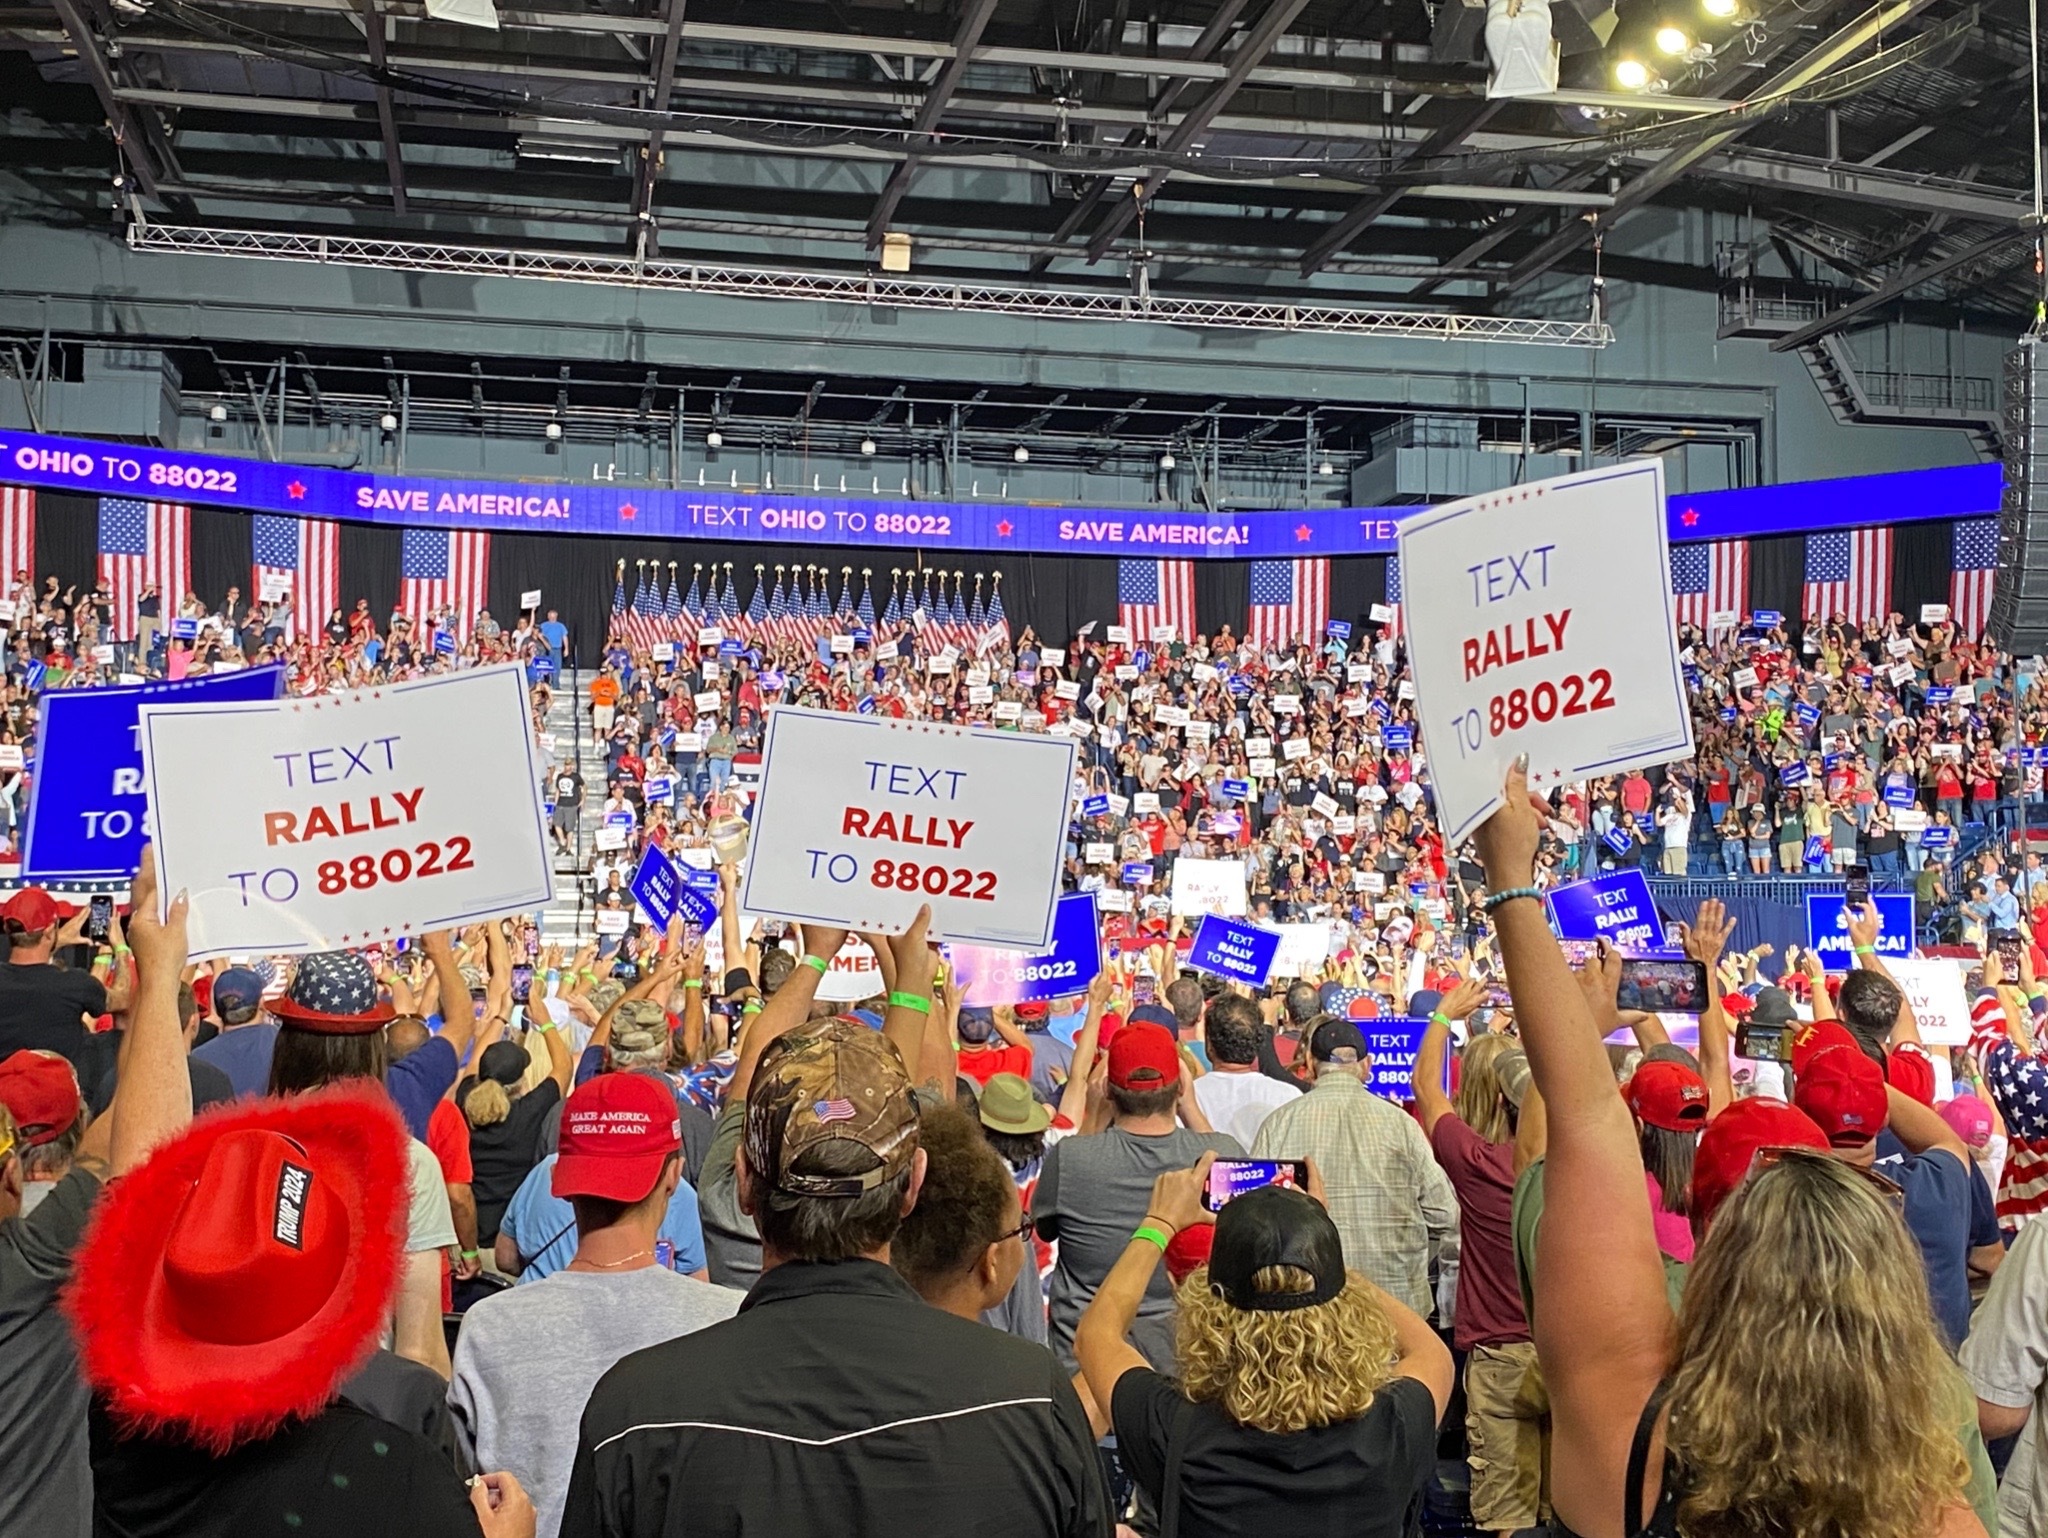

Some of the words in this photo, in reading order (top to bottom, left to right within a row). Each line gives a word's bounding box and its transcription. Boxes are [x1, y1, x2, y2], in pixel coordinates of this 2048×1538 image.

[15, 447, 94, 477] OHIO
[102, 457, 141, 482] TO
[149, 462, 238, 493] 88022
[356, 487, 430, 512] SAVE
[436, 492, 570, 518] AMERICA!
[688, 504, 753, 527] TEXT
[760, 509, 826, 531] OHIO
[833, 512, 867, 532] TO
[874, 513, 951, 536] 88022
[1059, 521, 1124, 542] SAVE
[1129, 523, 1249, 545] AMERICA!
[1467, 544, 1556, 607] TEXT
[1462, 608, 1573, 683] RALLY
[1451, 708, 1483, 760] TO
[1489, 668, 1616, 738] 88022
[273, 736, 401, 787] TEXT
[865, 761, 967, 800] TEXT
[80, 809, 133, 839] TO
[264, 787, 425, 847] RALLY
[842, 807, 975, 849] RALLY
[228, 868, 299, 907] TO
[317, 836, 475, 895] 88022
[659, 866, 675, 889] TEXT
[806, 850, 858, 883] TO
[871, 859, 998, 901] 88022
[641, 881, 652, 897] TO
[650, 875, 672, 902] RALLY
[1592, 888, 1628, 908] TEXT
[684, 892, 707, 914] TEXT
[1594, 905, 1639, 930] RALLY
[1217, 941, 1254, 960] RALLY
[1226, 930, 1255, 947] TEXT
[1817, 935, 1906, 951] AMECA!
[1014, 960, 1077, 982] 88022
[1206, 951, 1222, 964] TO
[1222, 957, 1257, 975] 88022
[1369, 1034, 1411, 1047] TEXT
[569, 1111, 599, 1122] MAKE
[599, 1111, 652, 1123] AMERICA
[571, 1124, 607, 1135] GREAT
[608, 1124, 647, 1135] AGAIN
[282, 1166, 308, 1204] 2024
[1229, 1169, 1265, 1182] 88022
[277, 1197, 300, 1245] TRUMP
